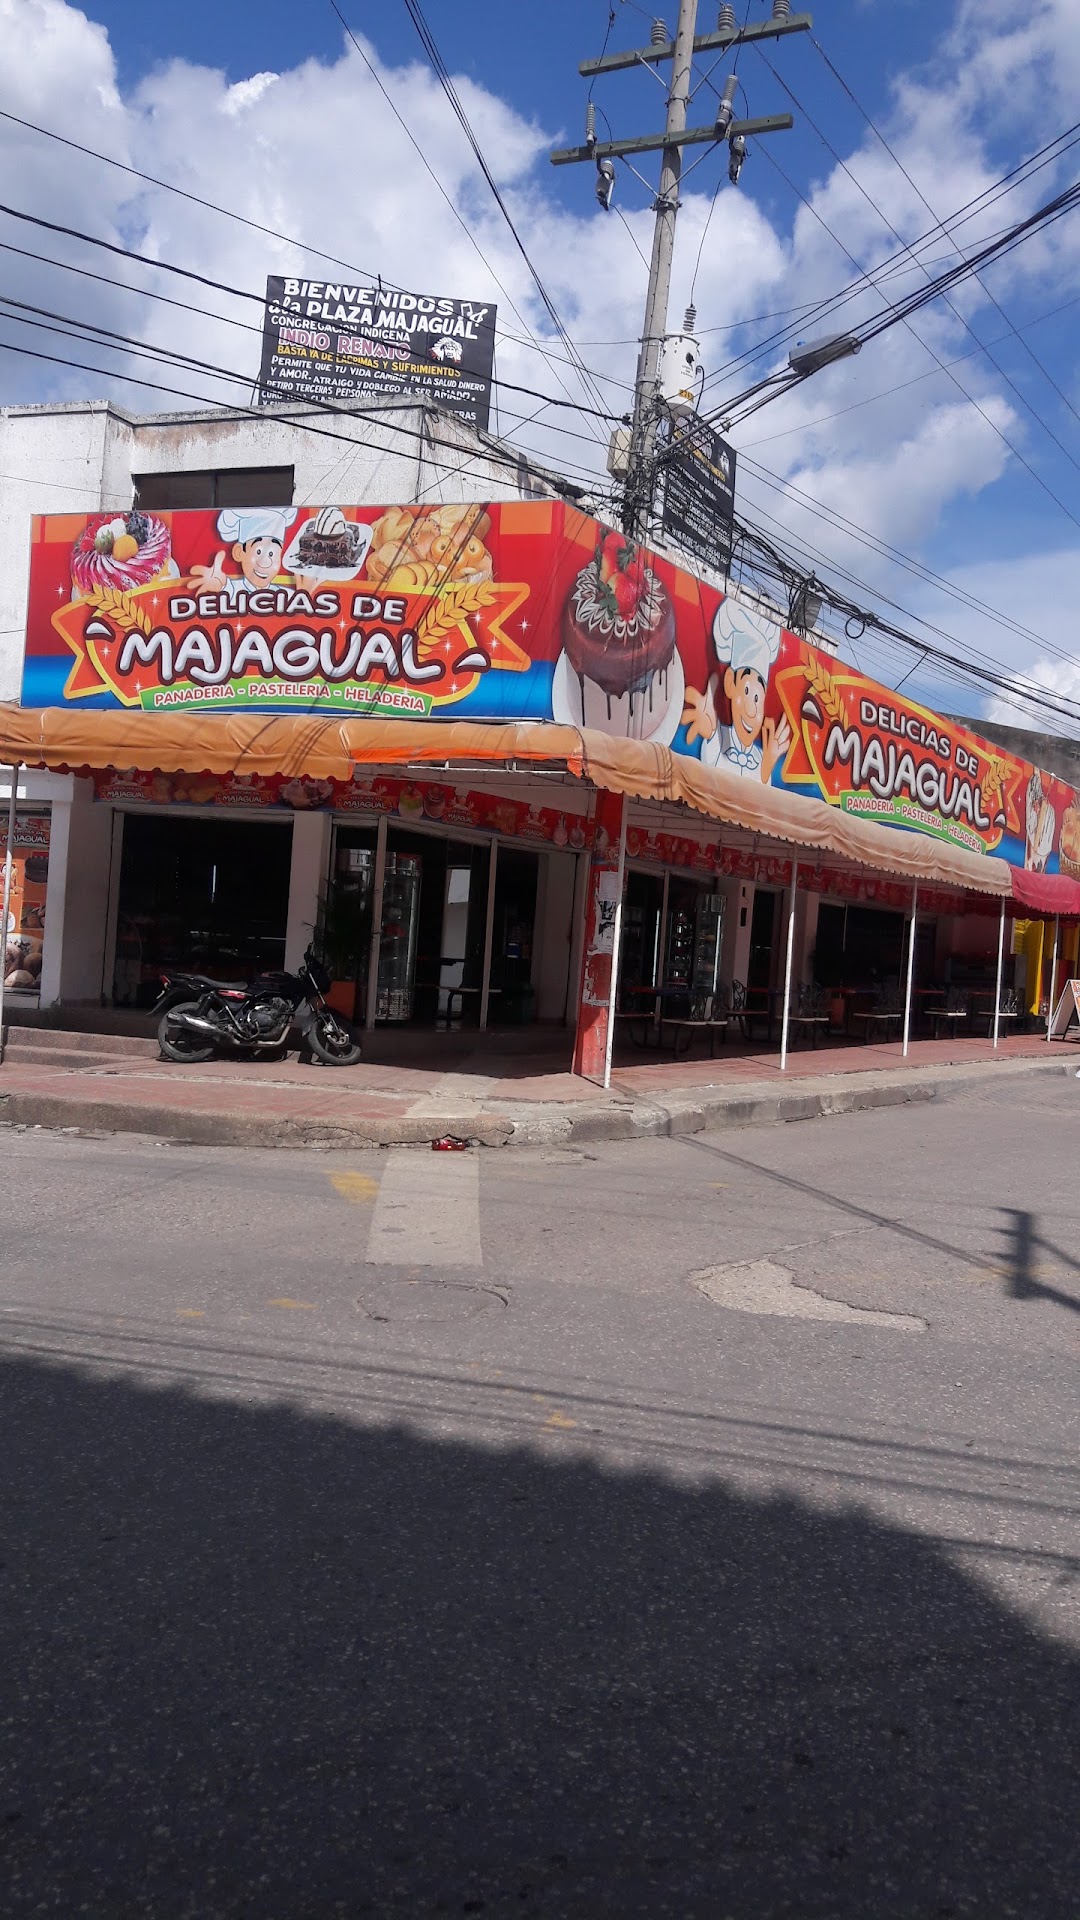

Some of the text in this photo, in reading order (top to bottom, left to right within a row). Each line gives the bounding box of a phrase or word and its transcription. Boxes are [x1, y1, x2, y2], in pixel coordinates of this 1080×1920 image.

[284, 279, 454, 316] BIENVENIDOS
[271, 315, 410, 342] CONGREGACION INDIGENA
[306, 301, 373, 325] PLAZA
[373, 310, 478, 340] MAJAGUAL
[278, 327, 411, 361] INDIO RENATO
[271, 355, 312, 369] PERMITE
[314, 362, 332, 372] QUE
[335, 365, 347, 374] TU
[350, 367, 371, 378] VIDA
[422, 377, 432, 385] LA
[433, 378, 457, 388] SALUD
[458, 381, 485, 392] DINERO
[277, 345, 307, 357] BASTA
[309, 349, 319, 359] YA
[321, 352, 333, 362] DE
[382, 360, 389, 370] Y
[391, 362, 461, 377] SUFRIMIENTOS
[270, 366, 277, 376] Y
[313, 376, 354, 388] ATRAIGO
[363, 381, 401, 393] DOBLEGO
[402, 387, 412, 395] AL
[295, 383, 334, 395] TERCERAS
[169, 591, 406, 622] DELICIAS DE
[118, 625, 444, 685] MAJAGUAL
[154, 685, 234, 705] PANADERIA
[249, 683, 330, 697] PASTELERIA
[345, 687, 425, 711] HELADERIA
[860, 698, 978, 778] DELICIAS DE
[823, 722, 990, 829] MAJAGUAL
[107, 791, 146, 799] MAJAGUAL
[222, 795, 264, 804] MAJAGUAL
[343, 800, 388, 809] MAJAGUAL
[847, 796, 895, 813] PANADERIA
[902, 806, 942, 829] PASTELERIA
[948, 824, 982, 852] HELADERIA
